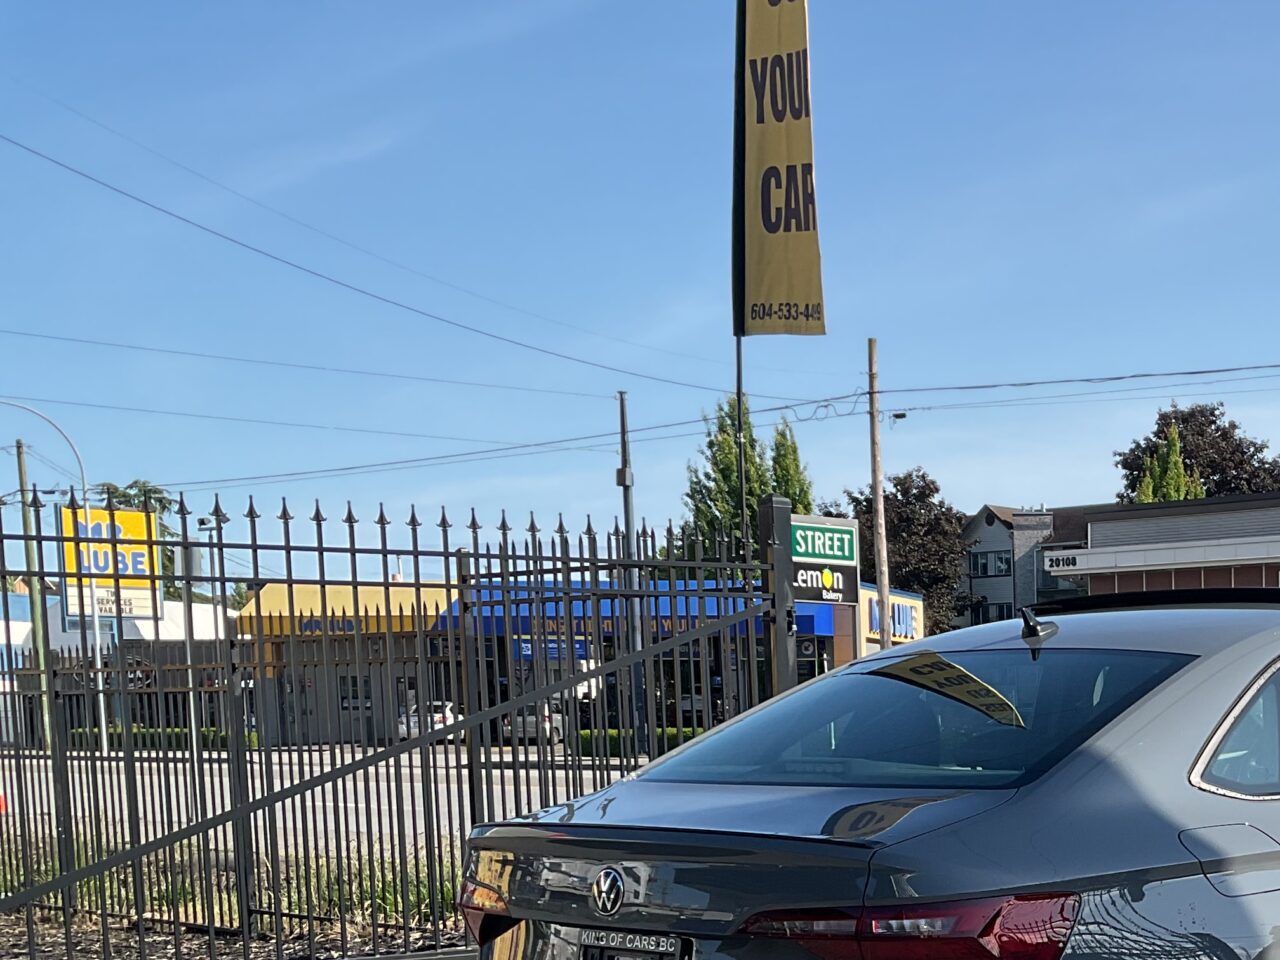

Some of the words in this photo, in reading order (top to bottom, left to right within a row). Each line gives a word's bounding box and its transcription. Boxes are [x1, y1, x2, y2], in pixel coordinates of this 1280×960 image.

[795, 529, 851, 557] STREET
[78, 548, 146, 575] LUBE
[1048, 555, 1077, 569] 20108
[792, 566, 843, 592] emon
[96, 598, 133, 607] SERVCES
[822, 589, 843, 602] Bakery
[581, 929, 606, 945] KING
[609, 932, 624, 946] OF
[625, 934, 657, 950] CARS
[658, 938, 676, 952] BC
